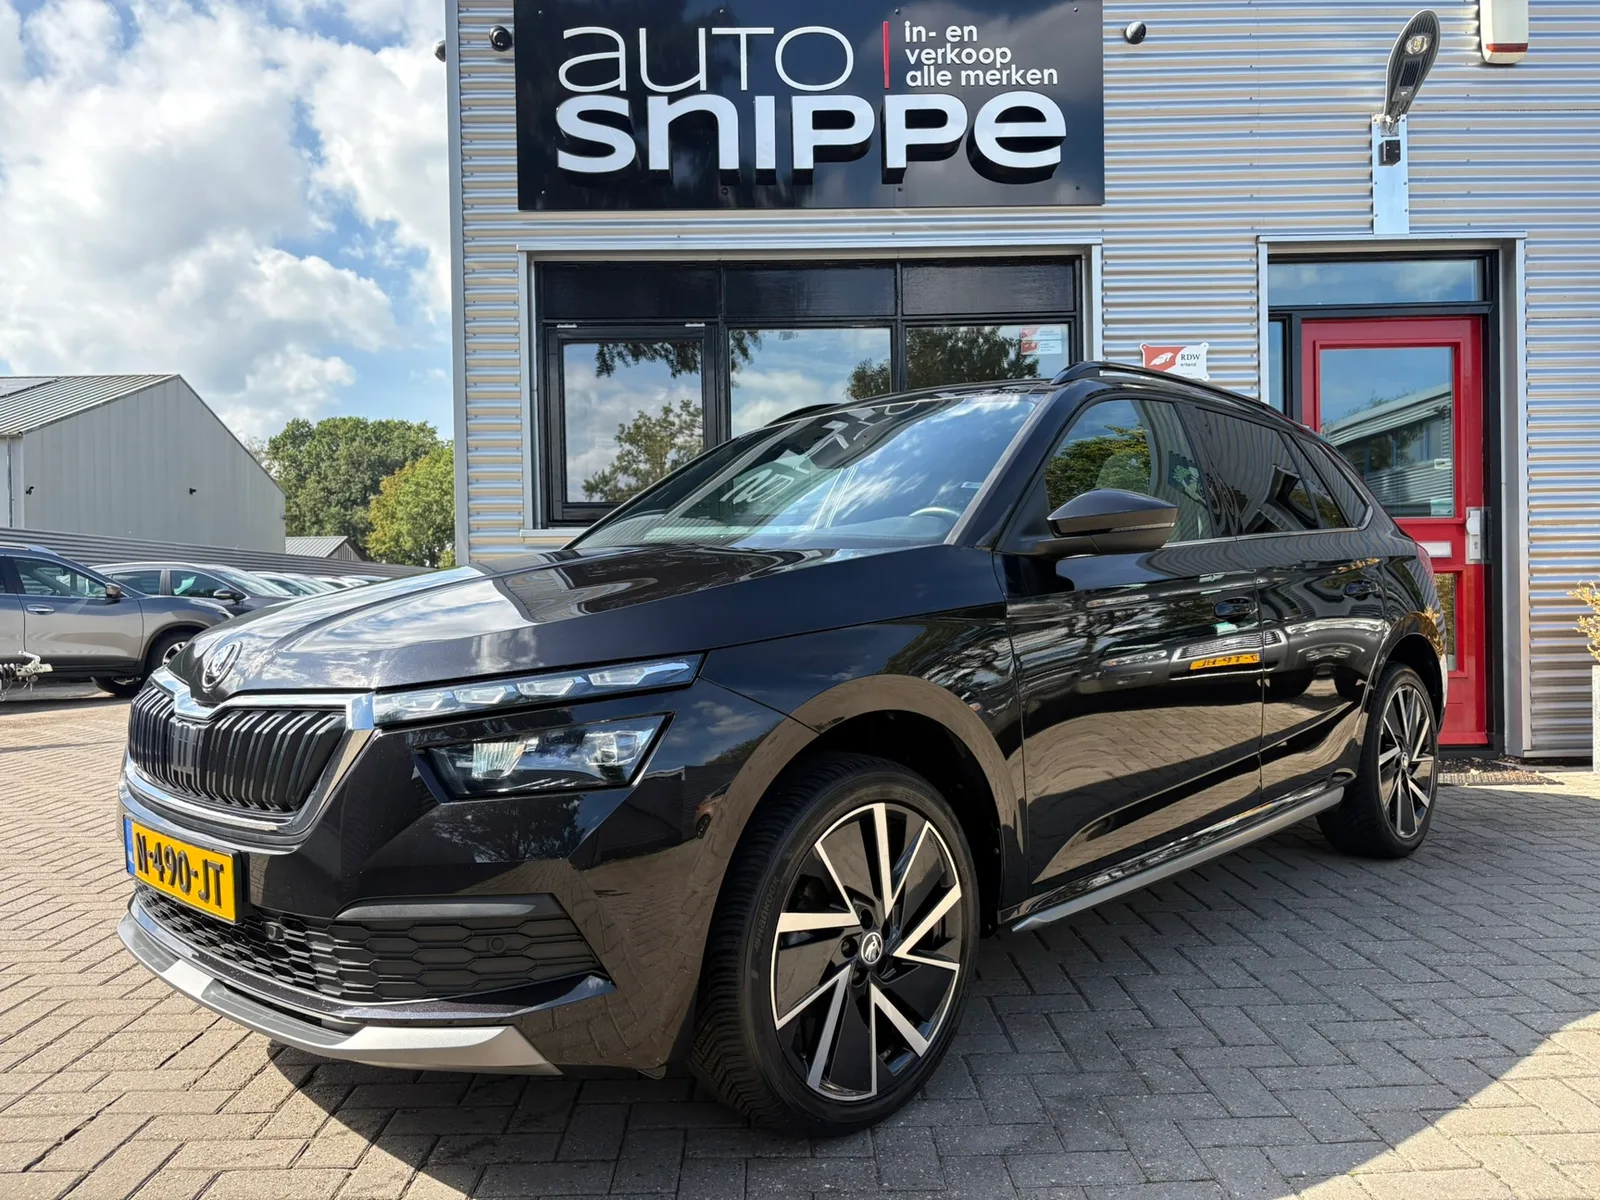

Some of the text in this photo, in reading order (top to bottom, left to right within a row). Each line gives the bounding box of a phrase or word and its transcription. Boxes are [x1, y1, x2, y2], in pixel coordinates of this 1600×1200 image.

[904, 20, 978, 42] in- en
[905, 43, 1012, 68] verkoop
[905, 64, 1058, 87] alle merken
[1180, 353, 1201, 361] RDW
[136, 832, 225, 908] N-490-JT
